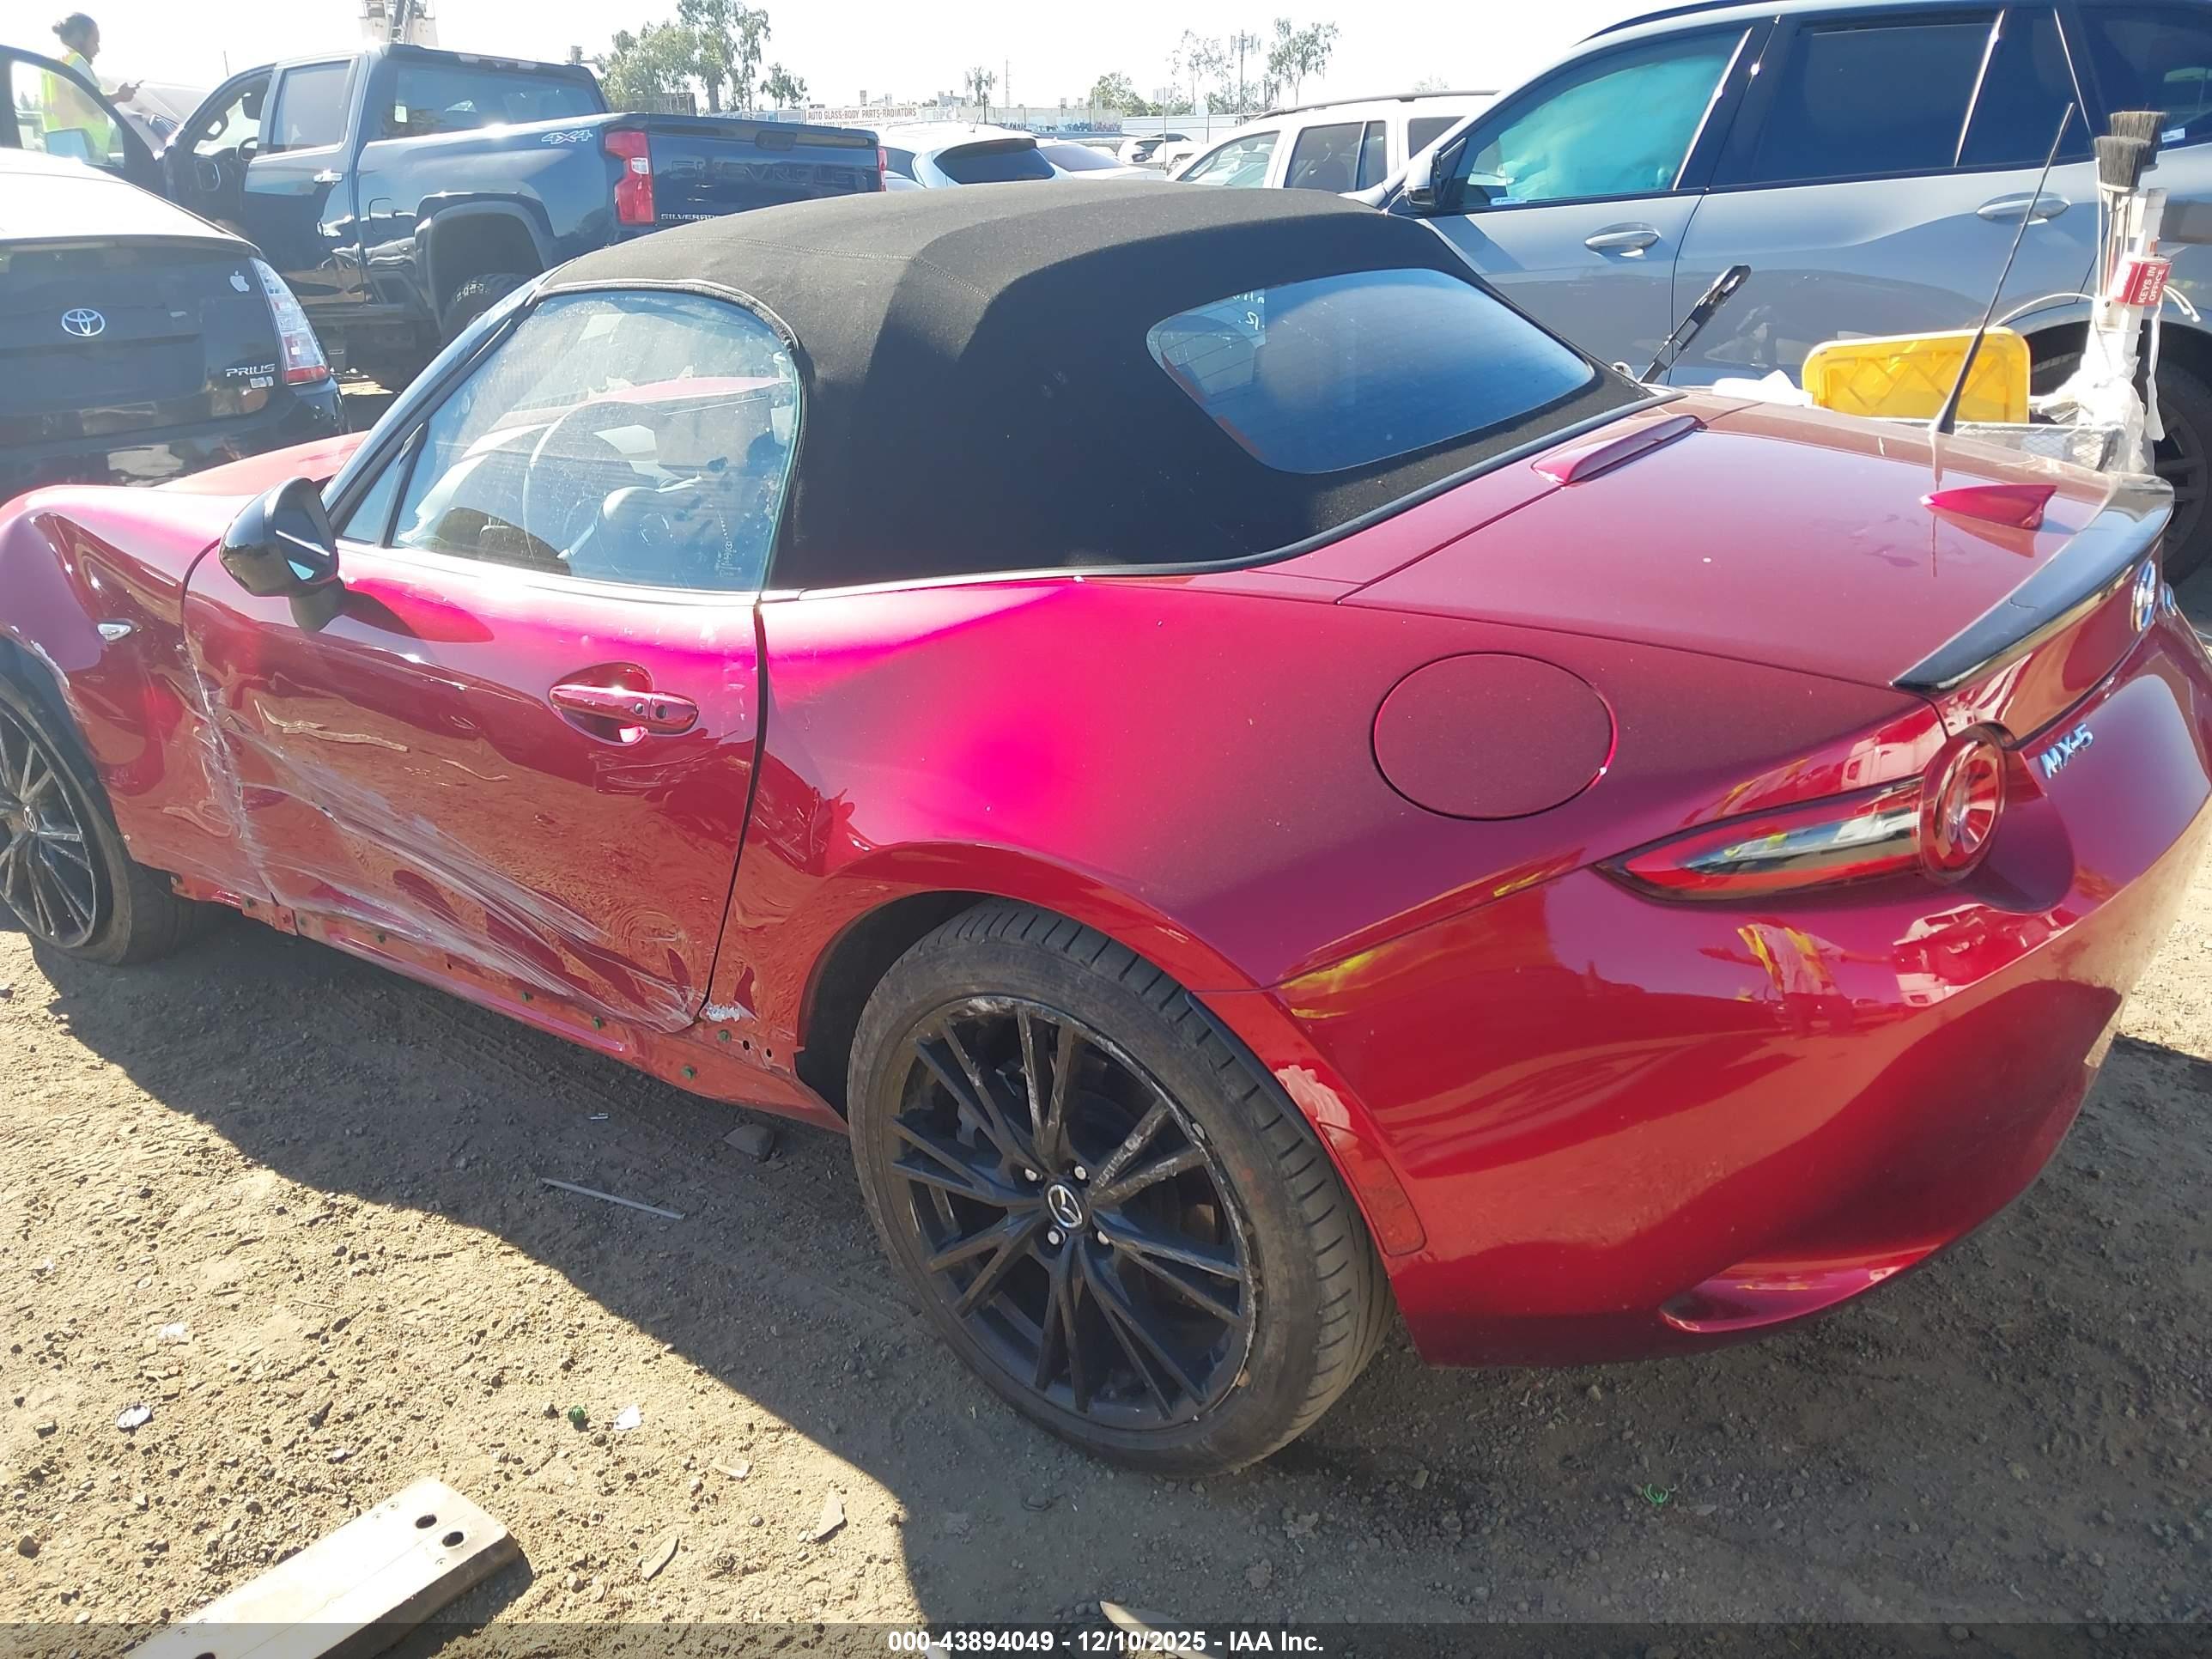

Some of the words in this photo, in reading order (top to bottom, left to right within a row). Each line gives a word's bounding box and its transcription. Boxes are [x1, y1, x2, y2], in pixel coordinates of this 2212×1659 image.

[808, 111, 823, 120] AUTO
[823, 110, 860, 120] GLASS-BODY
[861, 107, 917, 118] PARTS-RADIATORS
[2137, 279, 2152, 303] KEYS
[2147, 266, 2157, 276] IN
[2148, 269, 2166, 301] OFFICE
[225, 363, 276, 377] PRIUS
[2039, 723, 2094, 779] MX-5
